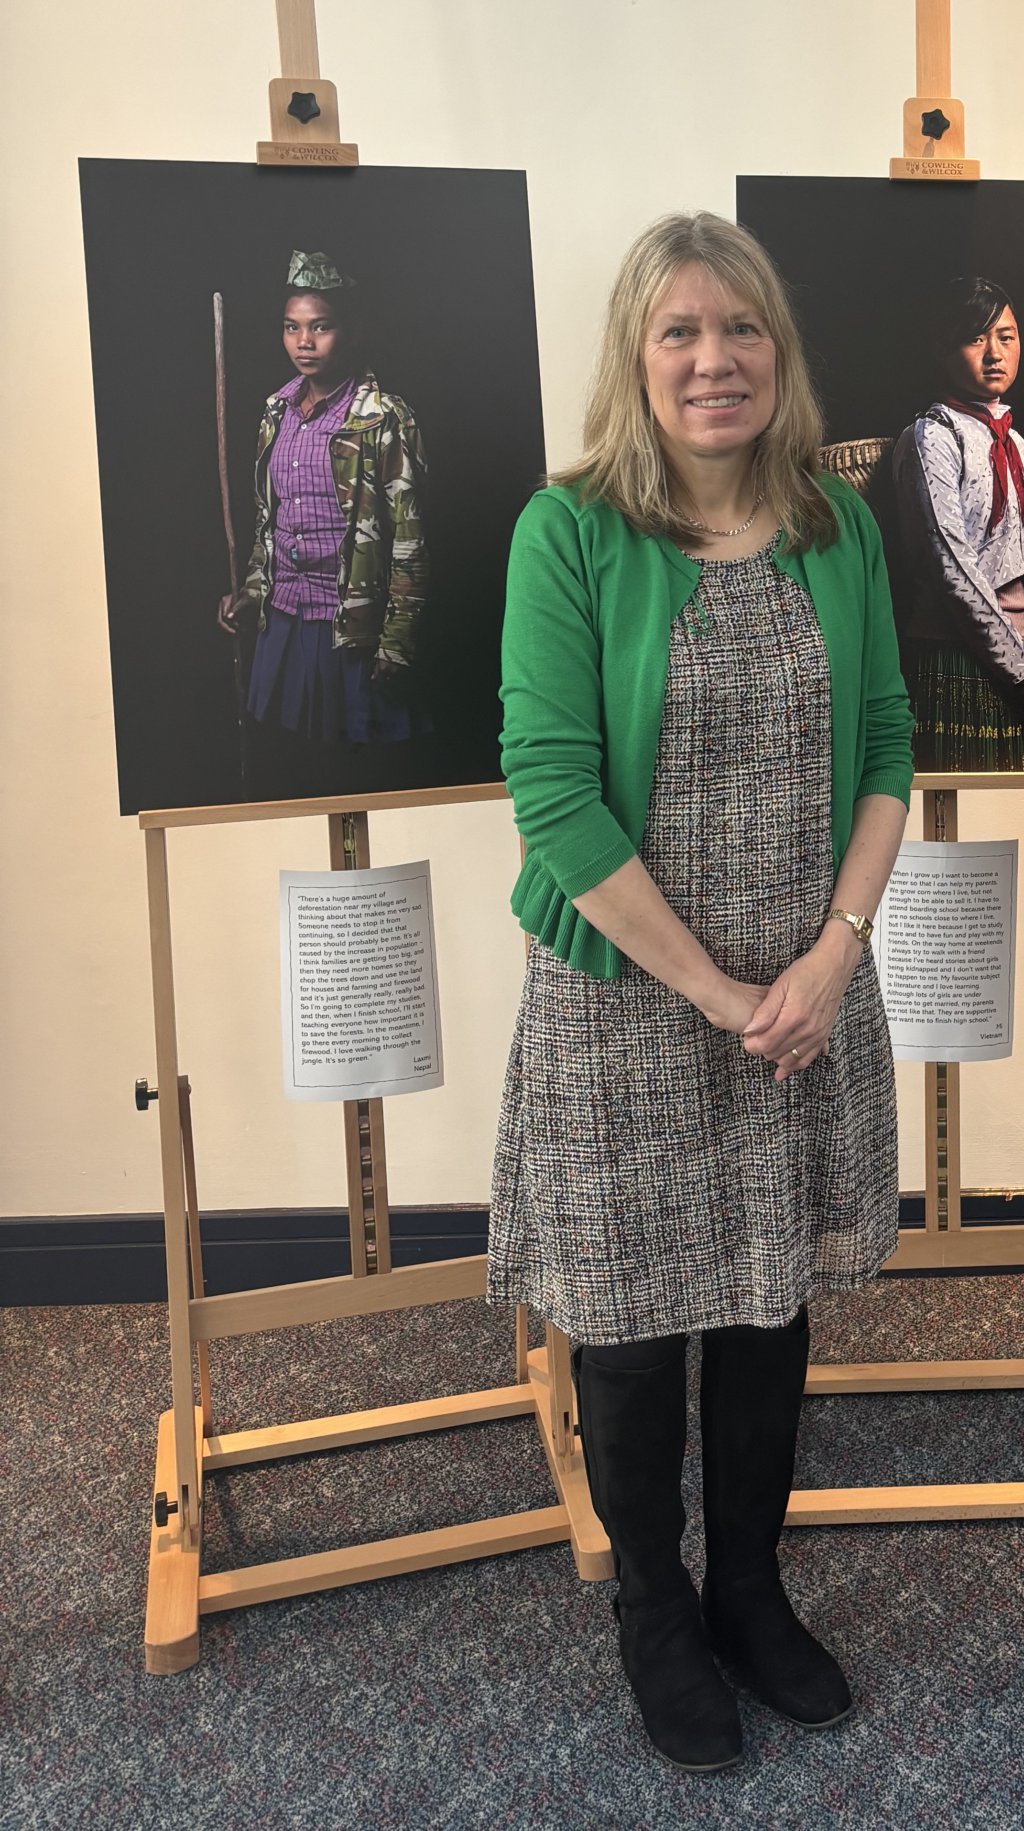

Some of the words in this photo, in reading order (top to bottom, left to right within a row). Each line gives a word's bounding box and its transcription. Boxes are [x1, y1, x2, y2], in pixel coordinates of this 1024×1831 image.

[909, 905, 938, 914] boarding
[351, 928, 379, 936] decided
[986, 955, 999, 964] girls
[887, 963, 905, 972] being
[905, 964, 939, 973] kidnapped
[895, 972, 918, 981] happen
[980, 972, 1000, 981] subject
[886, 989, 915, 998] Although
[322, 1003, 344, 1011] going
[353, 1000, 386, 1008] complete
[972, 999, 994, 1008] parents
[380, 1014, 412, 1024] important
[391, 1031, 412, 1040] collect
[382, 1040, 410, 1050] through
[414, 1062, 432, 1072] Nepal
